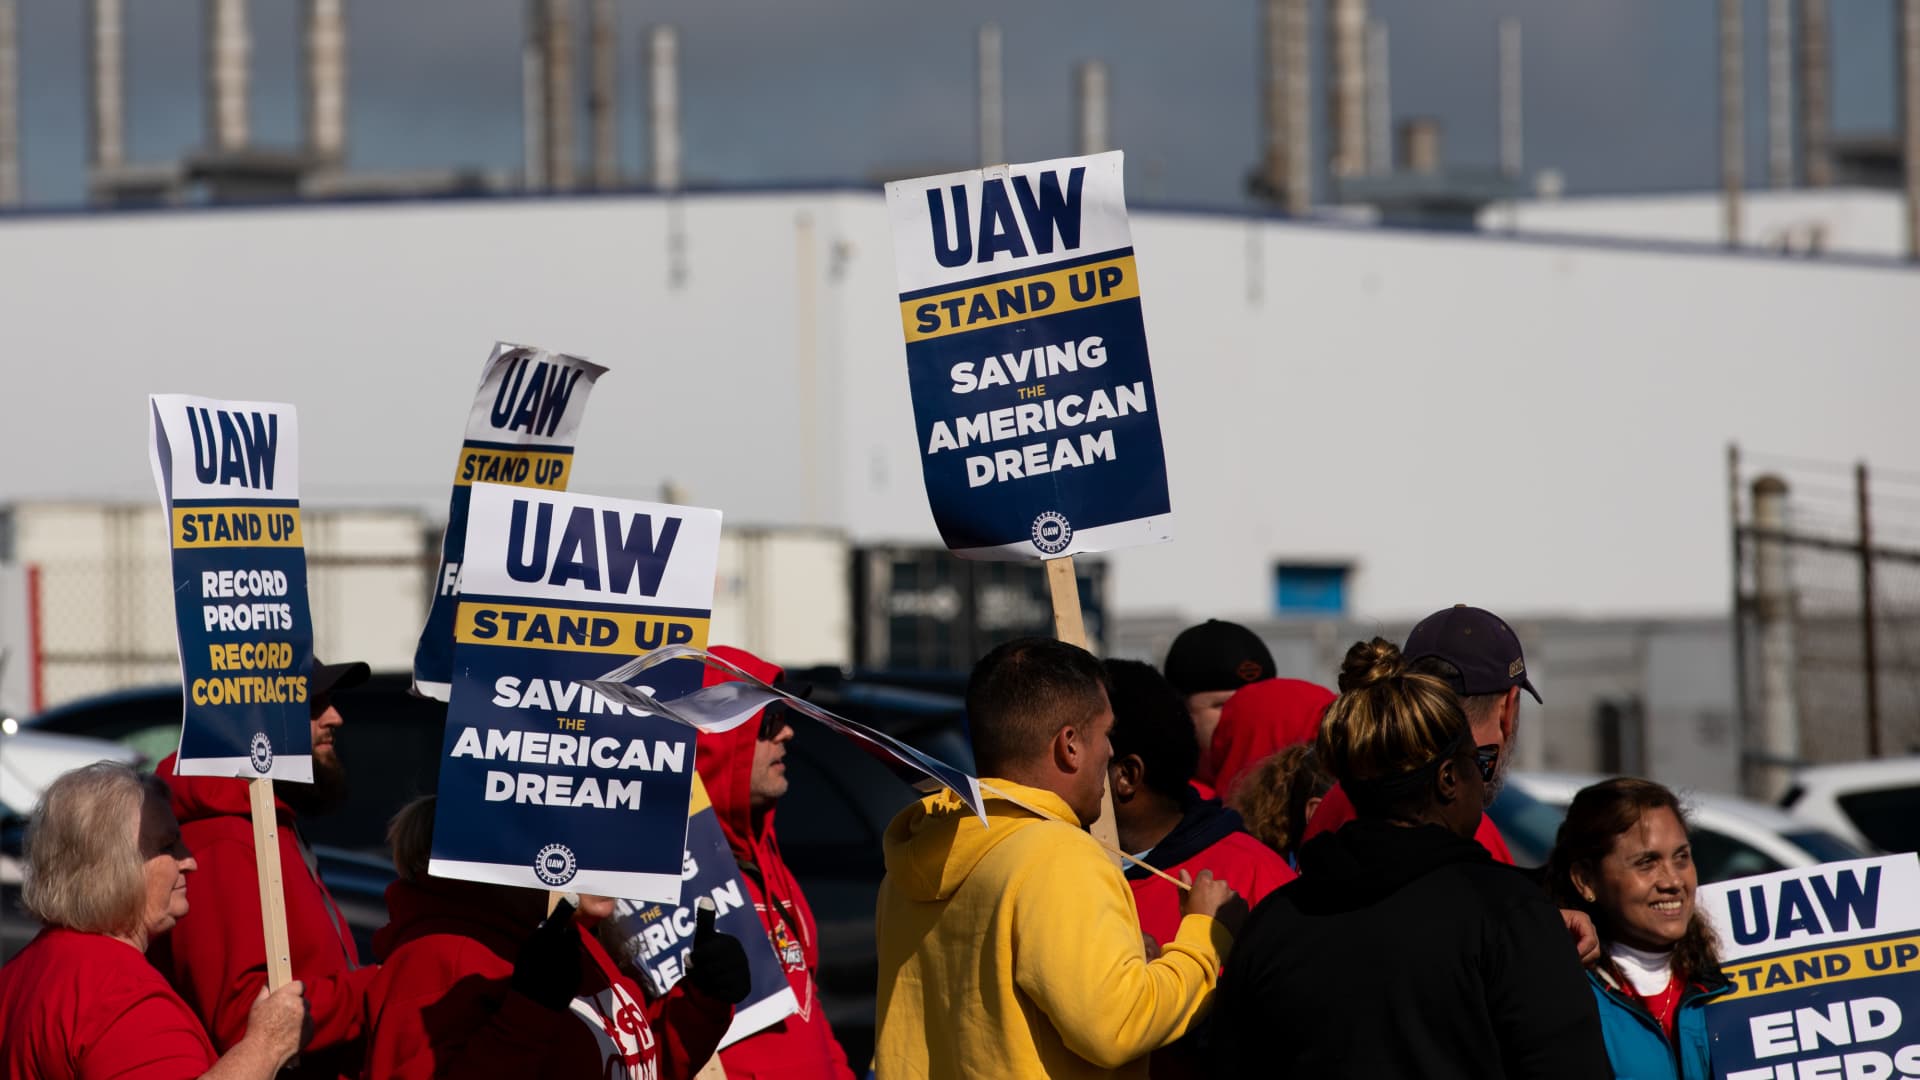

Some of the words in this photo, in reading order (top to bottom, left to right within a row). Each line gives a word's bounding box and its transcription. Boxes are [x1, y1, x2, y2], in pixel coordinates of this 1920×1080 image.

[926, 166, 1086, 268] UAW
[915, 280, 1056, 334] STAND
[1069, 266, 1124, 302] UP
[950, 336, 1107, 394] SAVING
[489, 355, 585, 438] UAW
[1017, 384, 1046, 399] THE
[927, 381, 1148, 454] AMERICAN
[186, 406, 278, 490] UAW
[966, 430, 1116, 489] DREAM
[461, 455, 530, 484] STAND
[535, 457, 564, 486] UP
[181, 512, 263, 543] STAND
[267, 514, 295, 543] UP
[506, 499, 682, 597] UAW
[1042, 526, 1059, 537] UAW
[202, 570, 288, 599] RECORD
[203, 604, 293, 632] PROFITS
[471, 609, 620, 648] STAND
[634, 621, 694, 651] UP
[210, 643, 293, 671] RECORD
[192, 676, 308, 706] CONTRACTS
[557, 718, 586, 732] THE
[450, 727, 686, 773] AMERICAN
[485, 770, 643, 810] DREAM
[546, 858, 565, 869] UAW
[640, 905, 663, 924] THE
[1726, 866, 1882, 946] UAW
[1726, 953, 1851, 995] STAND
[1864, 943, 1919, 971] UP
[1749, 996, 1903, 1060] END
